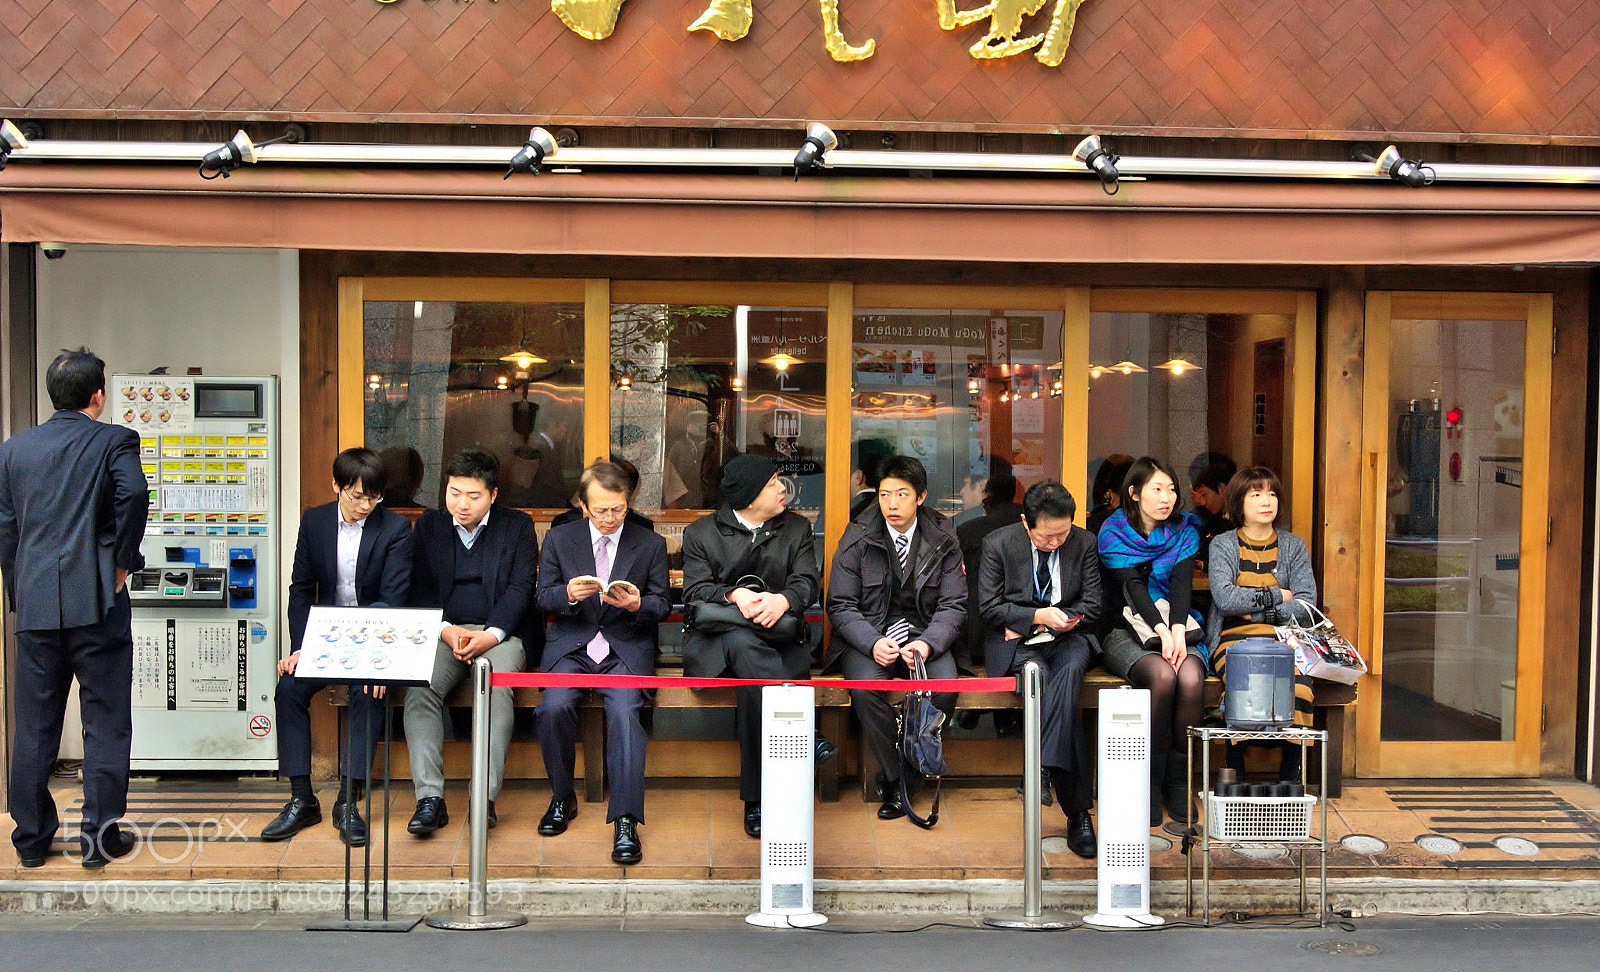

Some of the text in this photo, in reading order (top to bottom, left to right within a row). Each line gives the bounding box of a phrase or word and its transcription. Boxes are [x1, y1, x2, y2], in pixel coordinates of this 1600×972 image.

[167, 627, 175, 702] 順番をお待ちのお客様へ
[238, 627, 246, 702] お待ち頂いてるお客様へ
